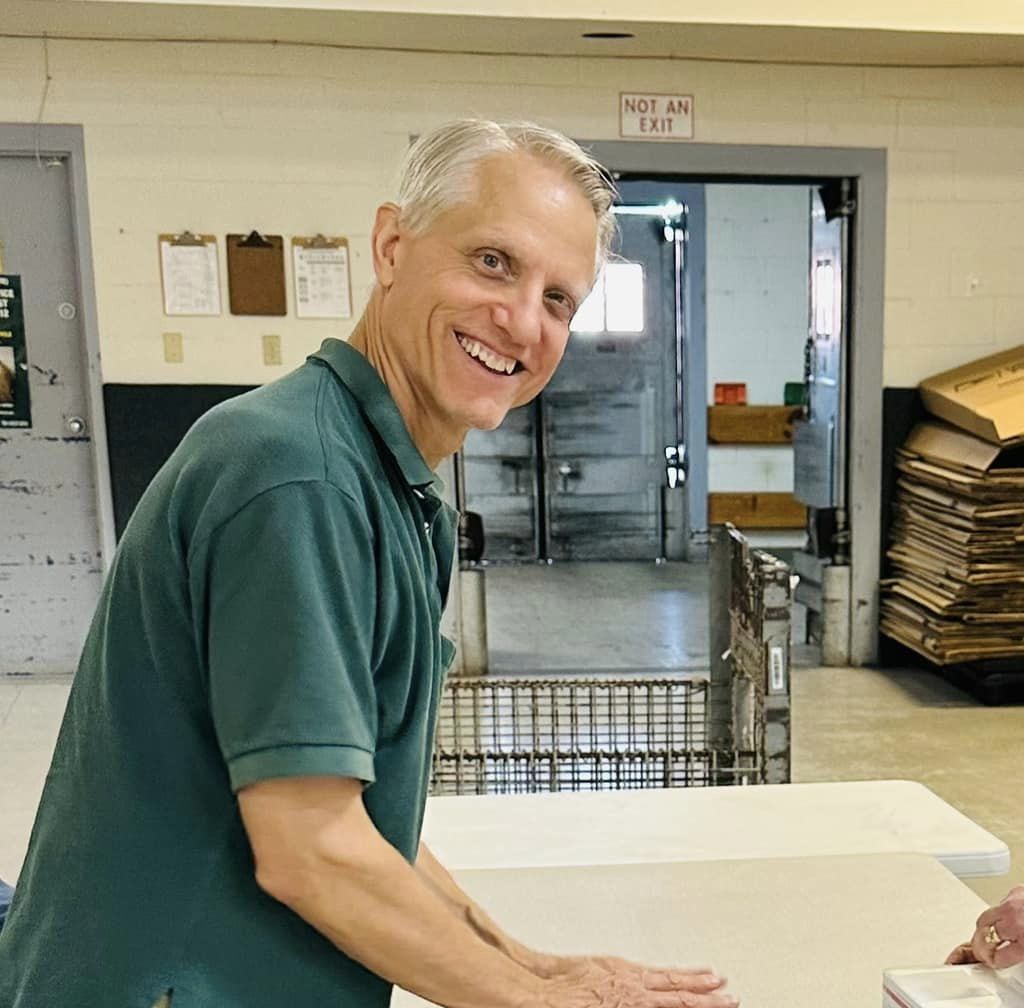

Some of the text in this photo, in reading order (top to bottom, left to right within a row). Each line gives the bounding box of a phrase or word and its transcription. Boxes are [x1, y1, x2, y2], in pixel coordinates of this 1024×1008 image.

[624, 98, 689, 115] NOT AN
[640, 117, 673, 132] EXIT
